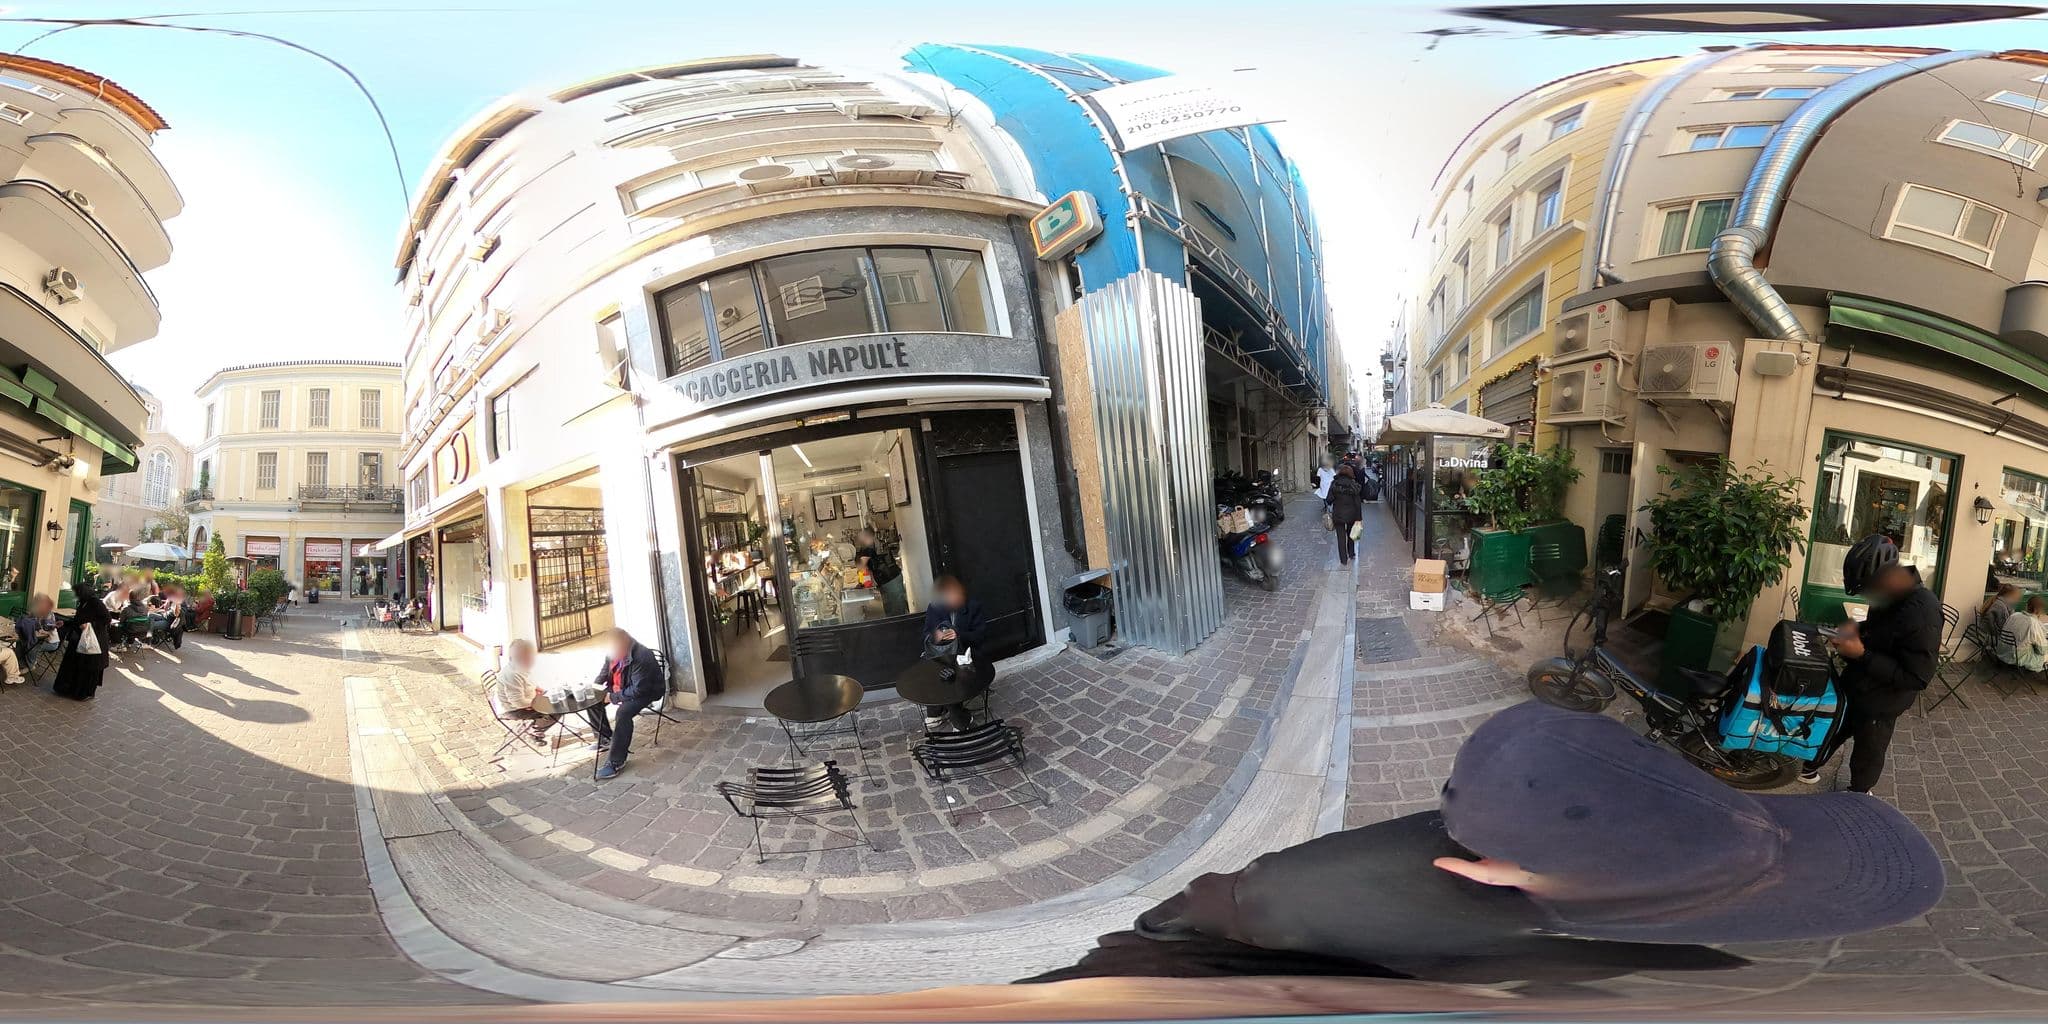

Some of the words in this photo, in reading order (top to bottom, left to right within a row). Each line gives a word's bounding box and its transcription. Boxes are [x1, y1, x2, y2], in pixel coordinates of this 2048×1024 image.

[1127, 105, 1241, 134] 210-6250770
[1704, 360, 1717, 368] LG
[674, 355, 797, 404] CACCERIA
[1792, 630, 1812, 657] Wolt
